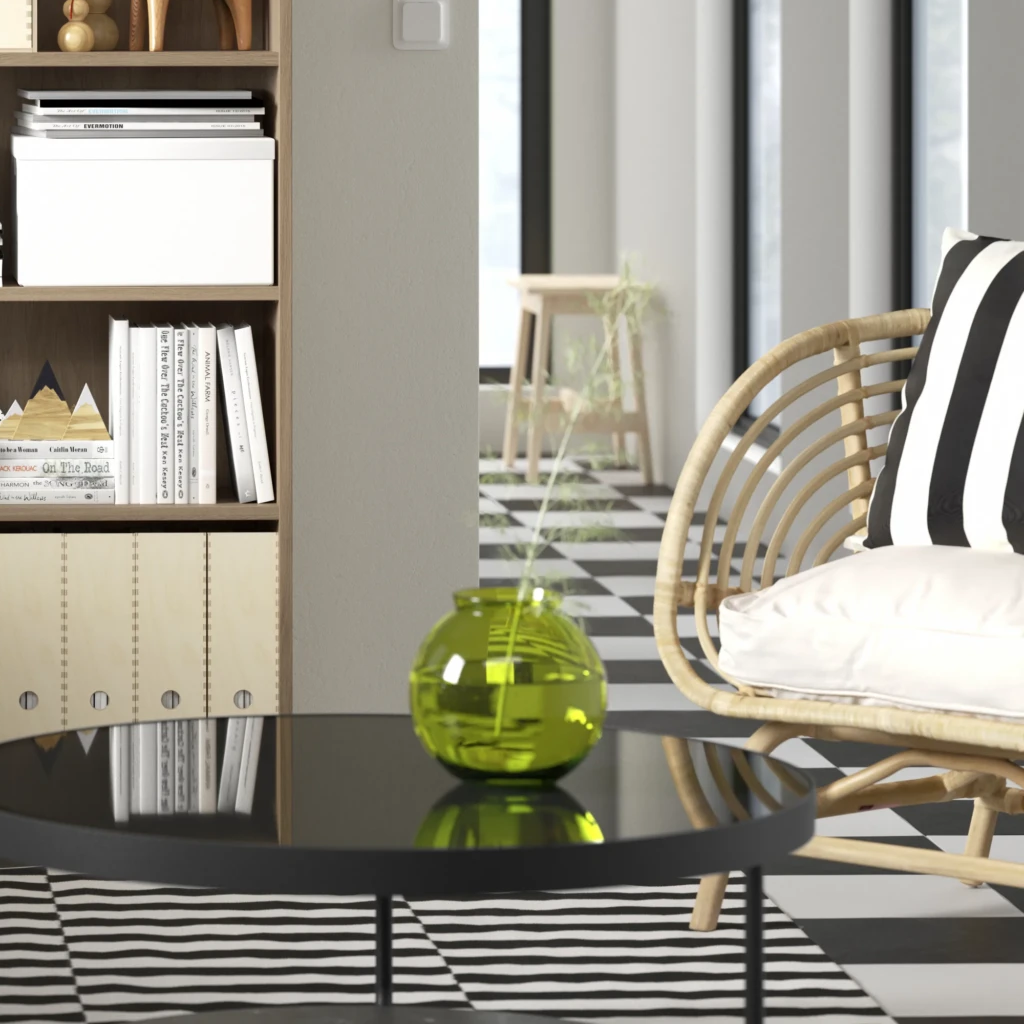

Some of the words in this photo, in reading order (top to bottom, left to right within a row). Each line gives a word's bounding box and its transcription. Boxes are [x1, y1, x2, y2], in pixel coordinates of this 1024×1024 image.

[161, 346, 169, 362] Flew
[161, 365, 169, 380] Over
[161, 384, 169, 396] The
[161, 399, 169, 430] Cuckoo's
[161, 433, 169, 448] Nest
[42, 462, 55, 473] On
[60, 462, 80, 473] The
[84, 462, 110, 473] Road
